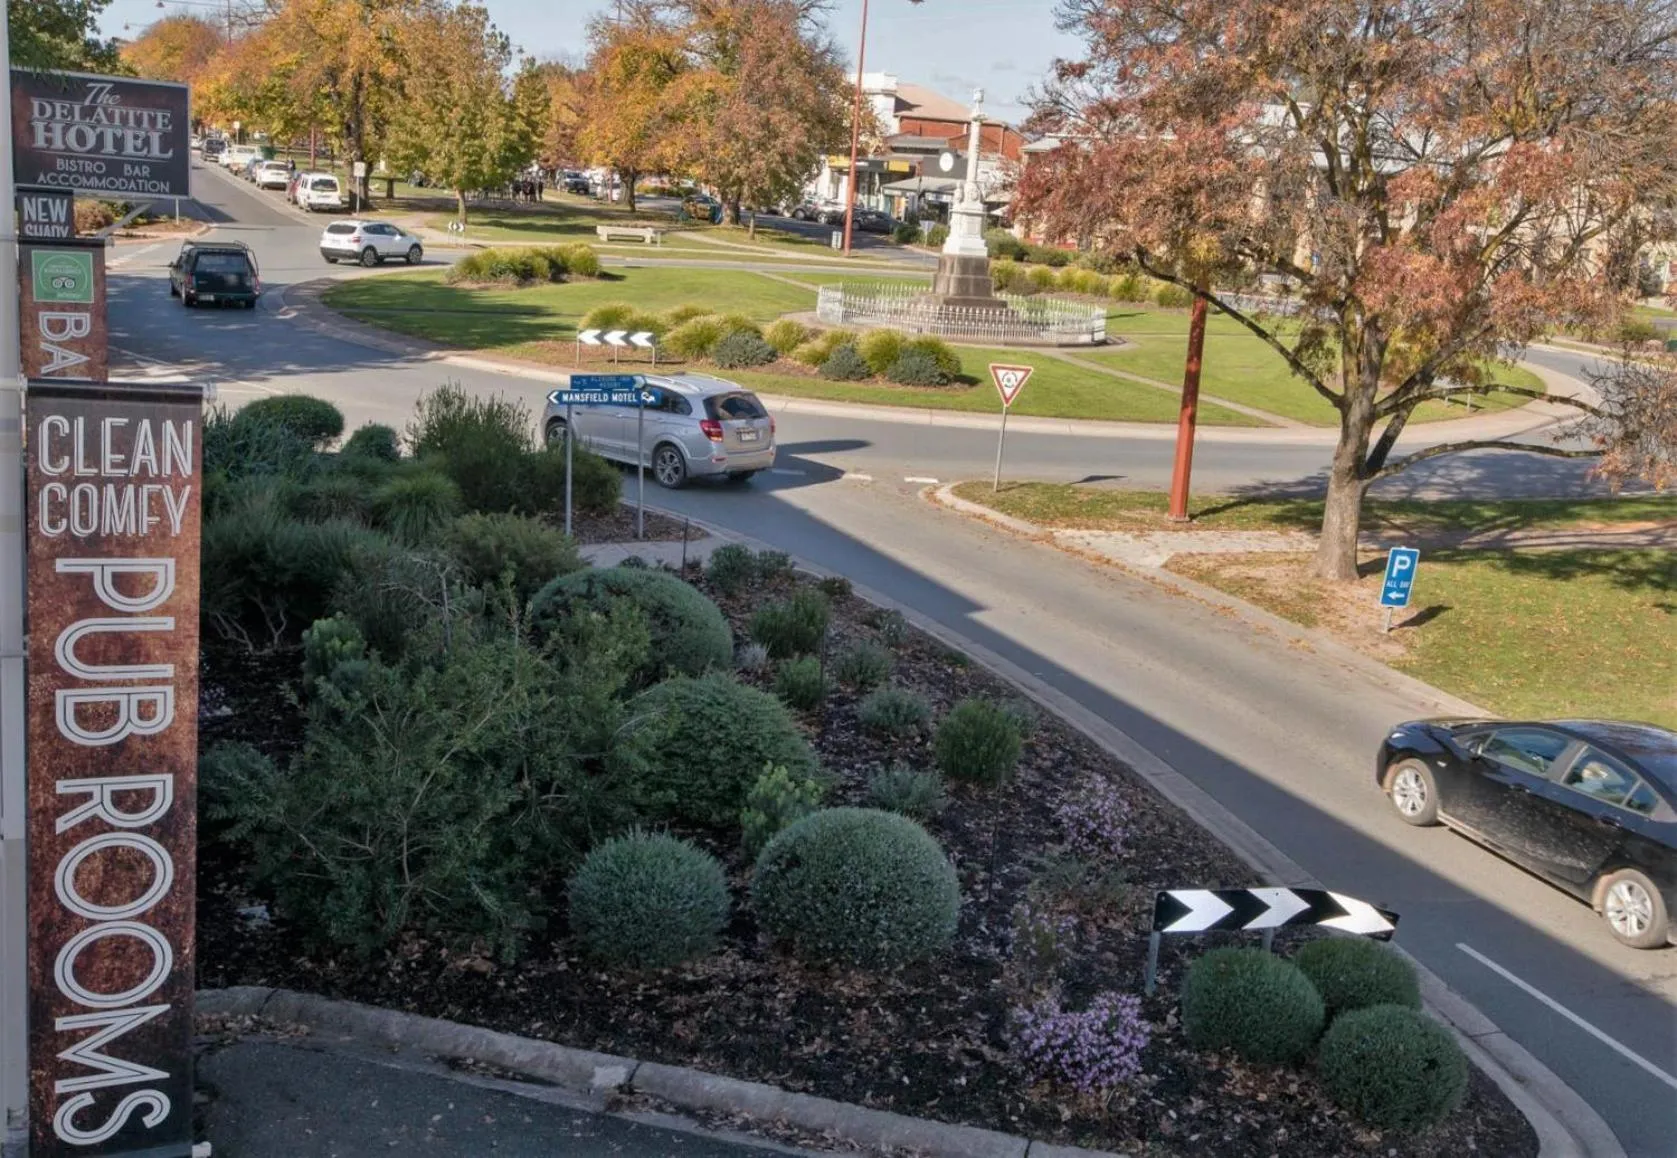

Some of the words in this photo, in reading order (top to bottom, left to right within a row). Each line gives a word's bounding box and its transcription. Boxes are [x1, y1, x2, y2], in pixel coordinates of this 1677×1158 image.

[84, 82, 121, 105] The
[31, 100, 173, 130] DELATITE
[31, 121, 174, 159] HOTEL
[37, 172, 171, 193] ACCOMMODATION
[56, 158, 106, 174] BISTRO
[123, 163, 151, 178] BAR
[23, 196, 68, 223] NEW
[39, 311, 92, 381] BA
[562, 392, 609, 403] MANSFIELD
[611, 392, 638, 403] MOTEL
[38, 415, 194, 478] CLEAN
[38, 482, 192, 538] COMFY
[1392, 555, 1412, 578] P
[55, 557, 176, 747] PUB
[53, 772, 174, 1146] ROOMS
